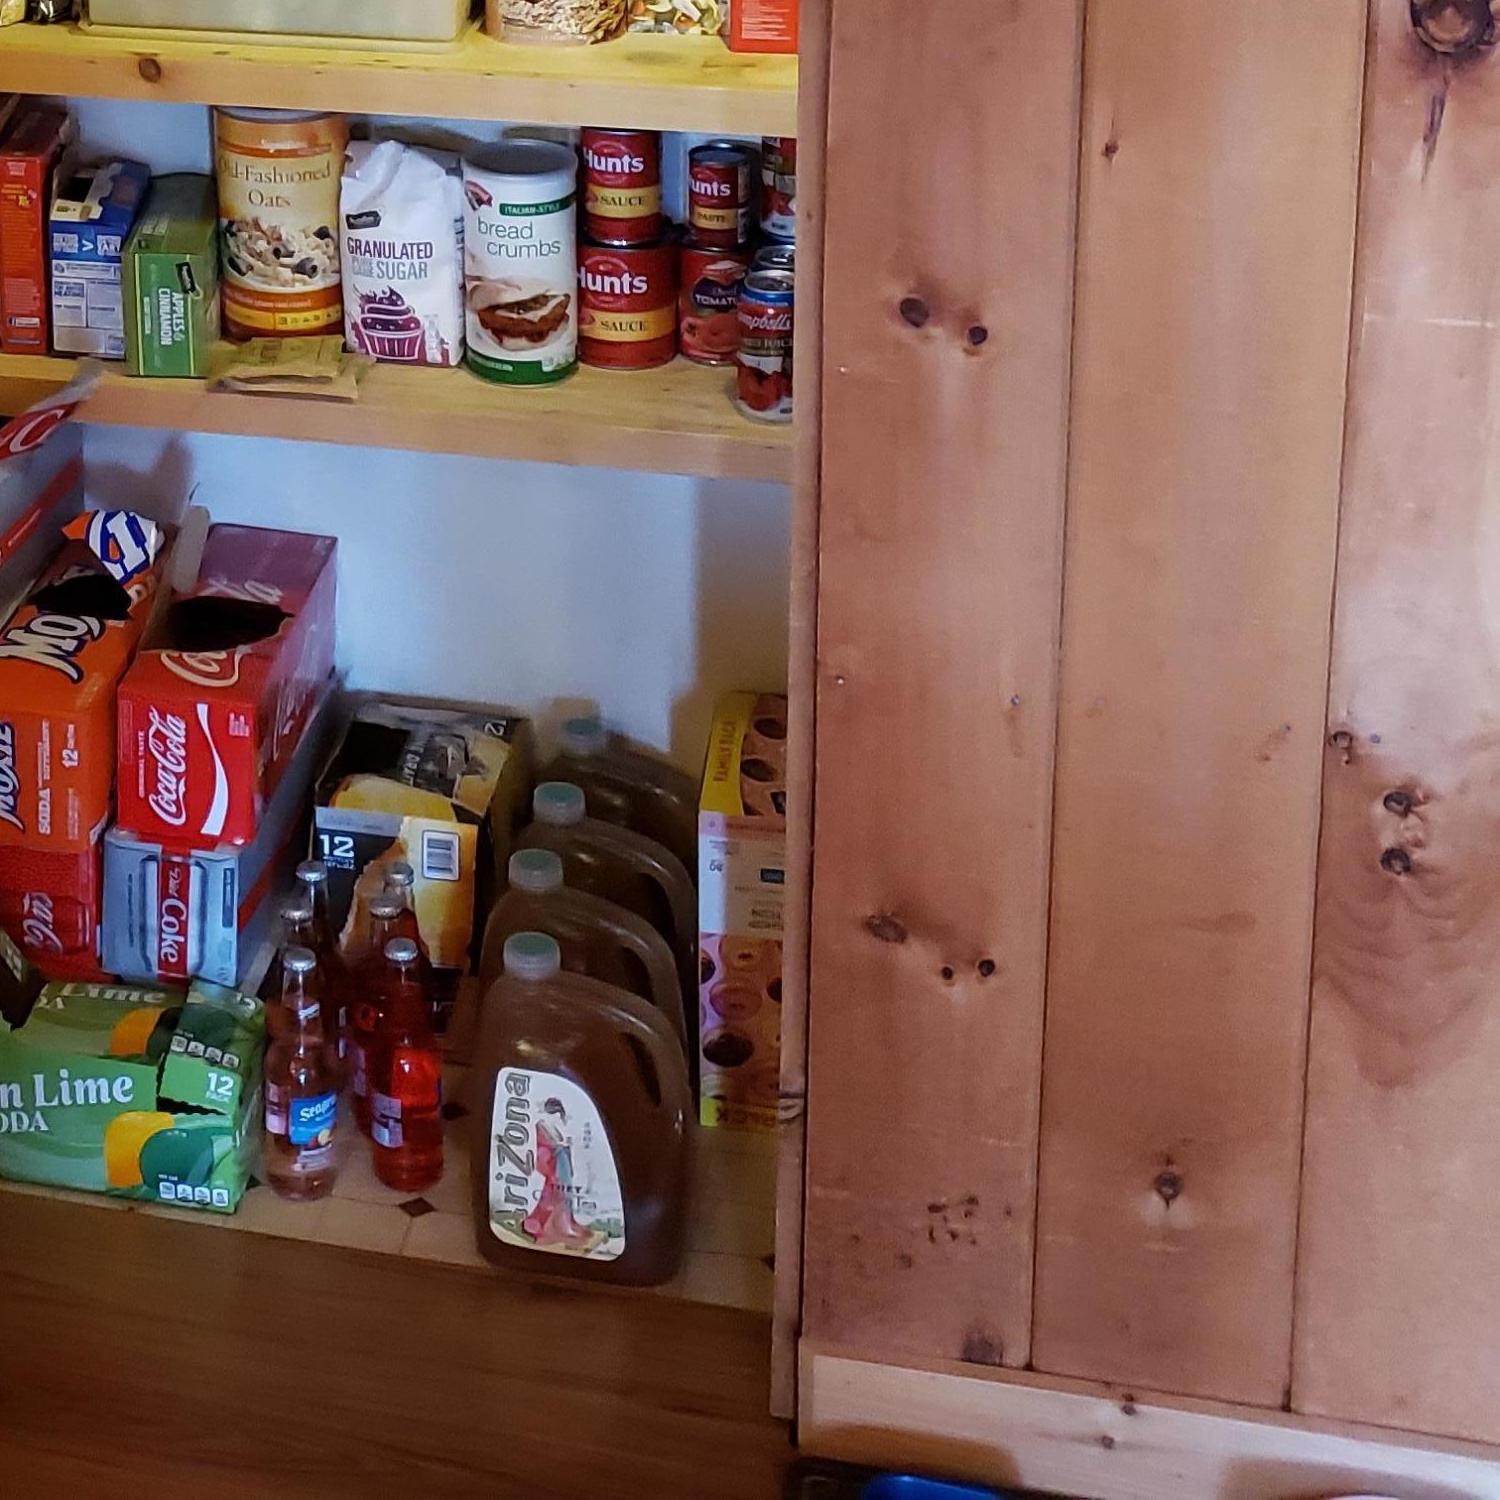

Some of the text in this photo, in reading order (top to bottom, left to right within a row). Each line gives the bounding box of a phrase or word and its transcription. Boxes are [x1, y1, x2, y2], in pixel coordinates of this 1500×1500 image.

[248, 189, 292, 209] Oats
[691, 177, 731, 197] unts
[601, 195, 645, 207] SAUCE
[477, 217, 534, 240] bread
[347, 236, 434, 260] GRANULATED
[486, 238, 562, 260] crumbs
[376, 261, 429, 281] SUGAR
[157, 287, 173, 346] CINNAMON
[171, 291, 185, 334] APPLES
[601, 319, 647, 332] SAUCE
[138, 730, 146, 758] TASTE
[38, 788, 51, 836] SODA
[319, 833, 355, 858] 12
[159, 897, 187, 964] Coke
[33, 1068, 136, 1108] Lime
[206, 1071, 233, 1095] 12
